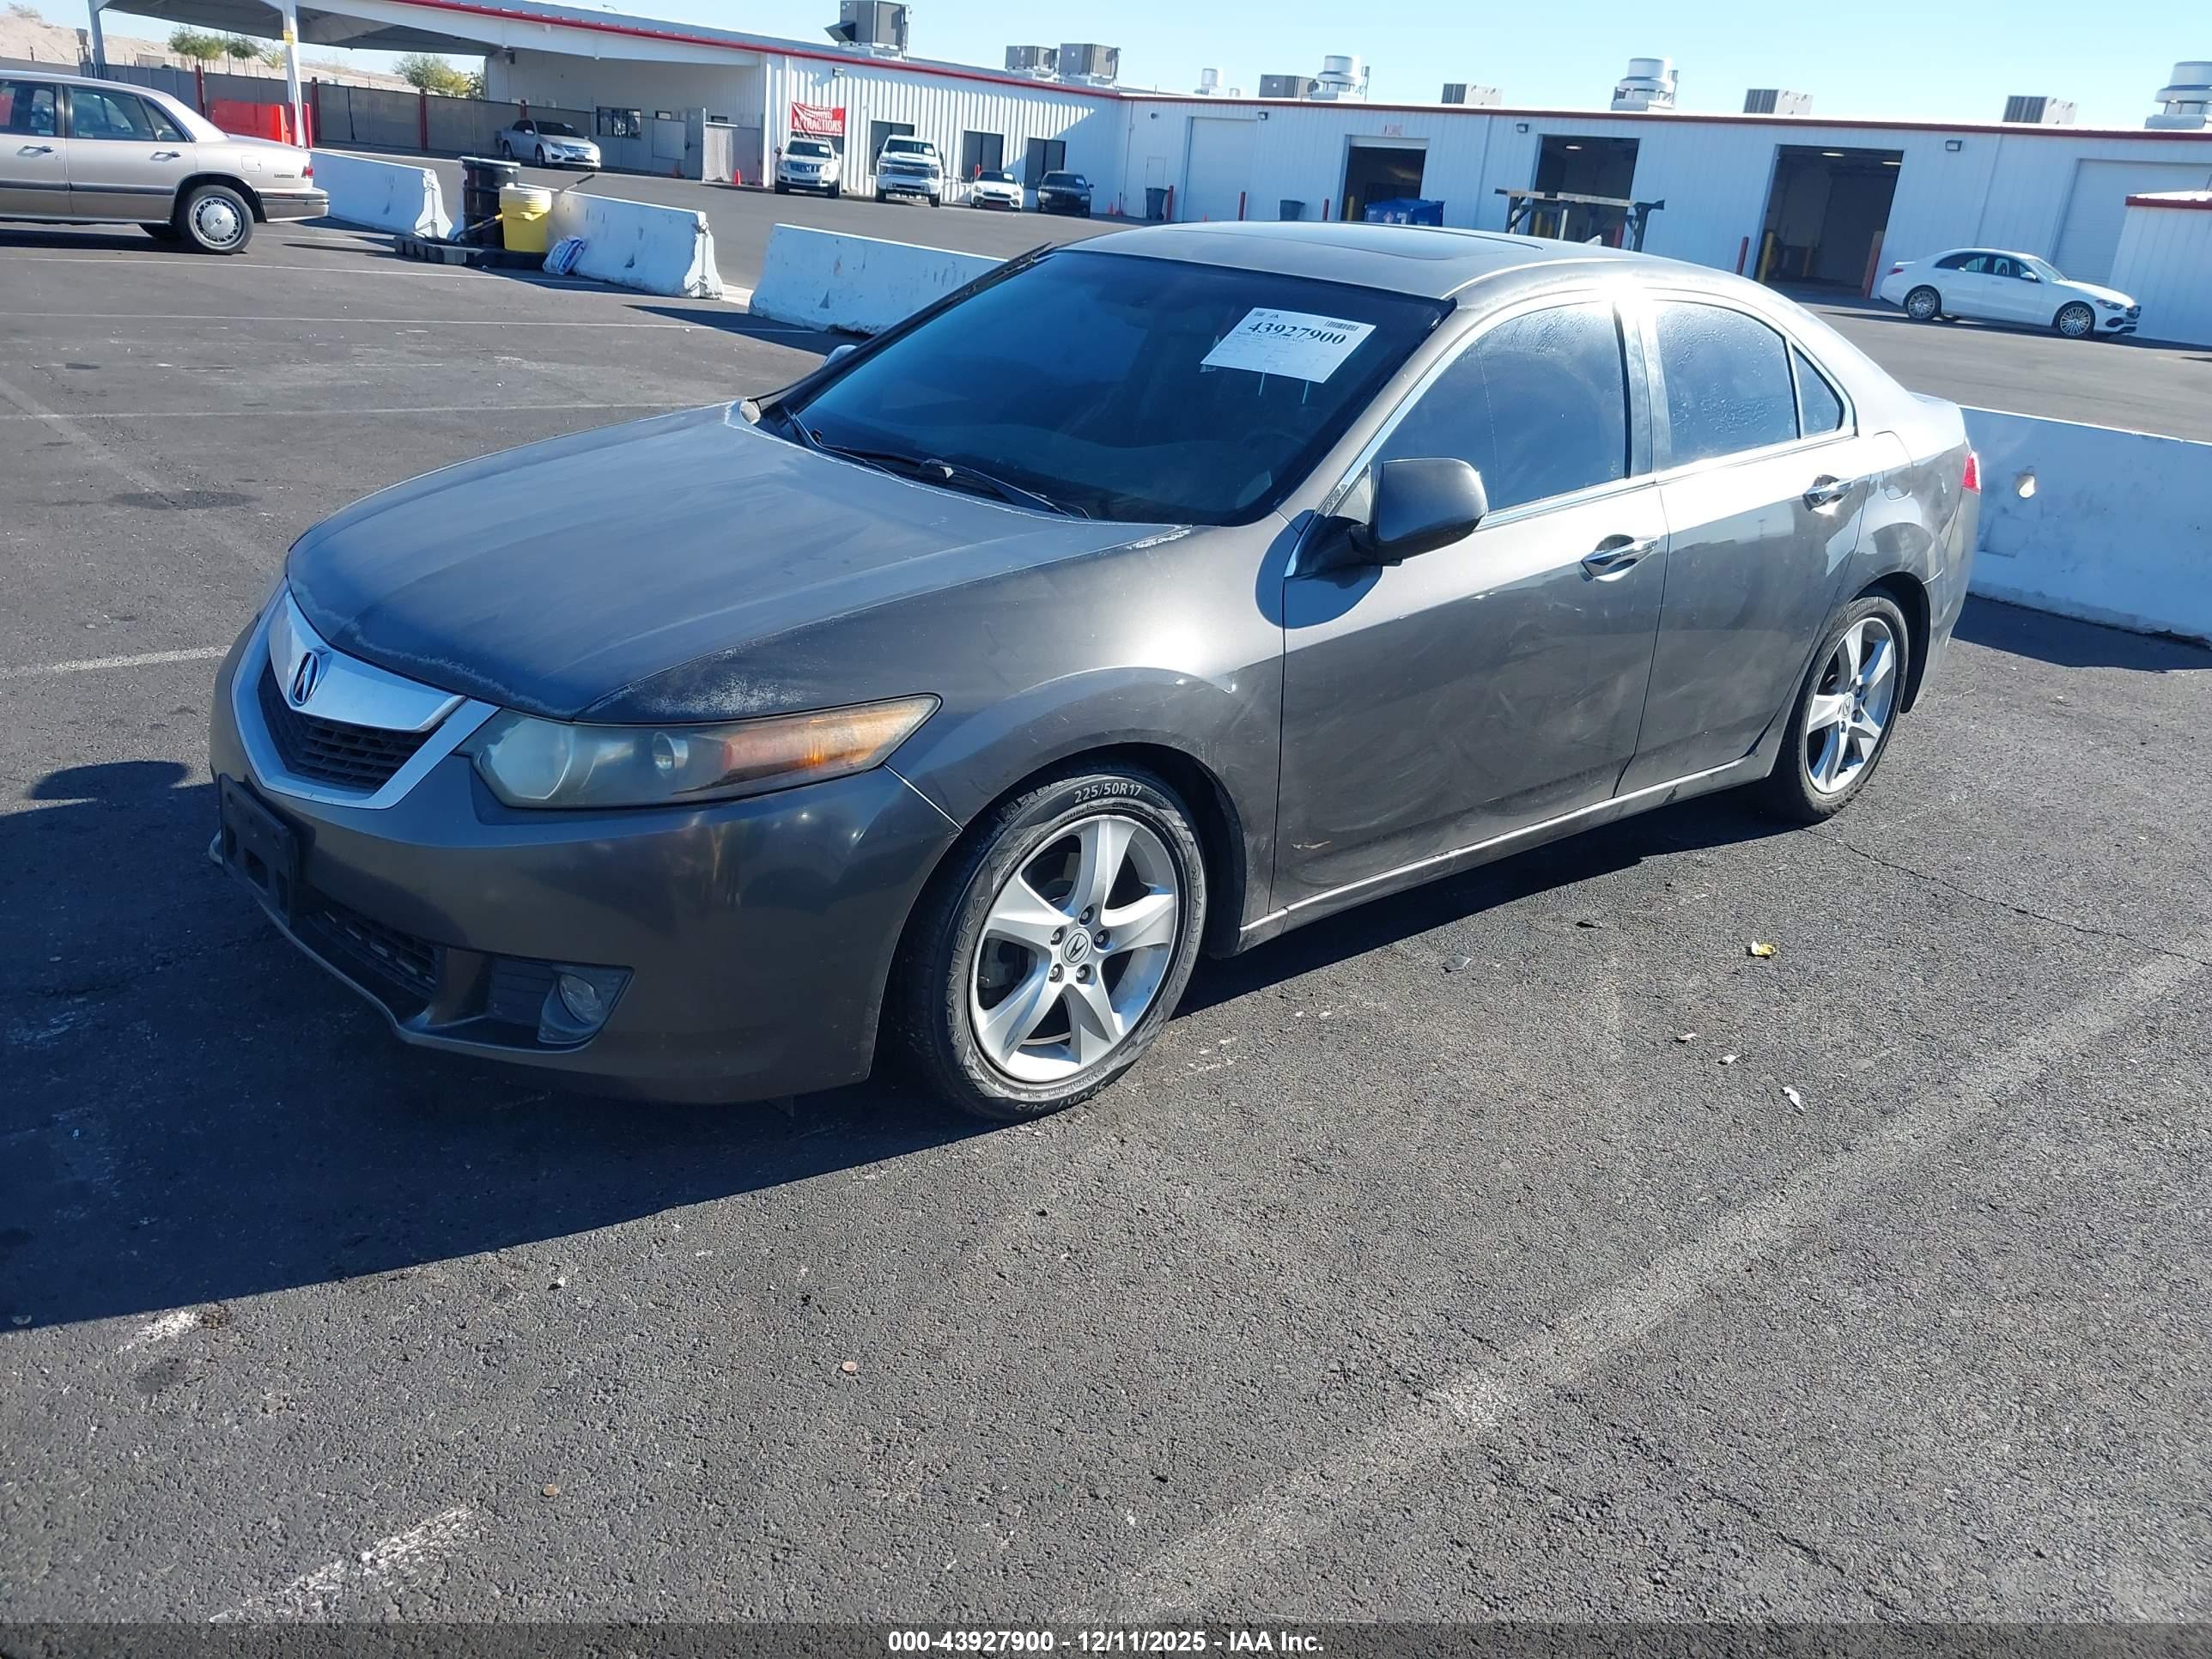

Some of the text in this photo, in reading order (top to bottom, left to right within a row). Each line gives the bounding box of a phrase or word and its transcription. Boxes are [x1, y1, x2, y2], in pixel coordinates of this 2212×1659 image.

[1248, 321, 1347, 345] 43927900
[1073, 782, 1142, 804] 225/50R17
[946, 896, 986, 1027] PANTERA
